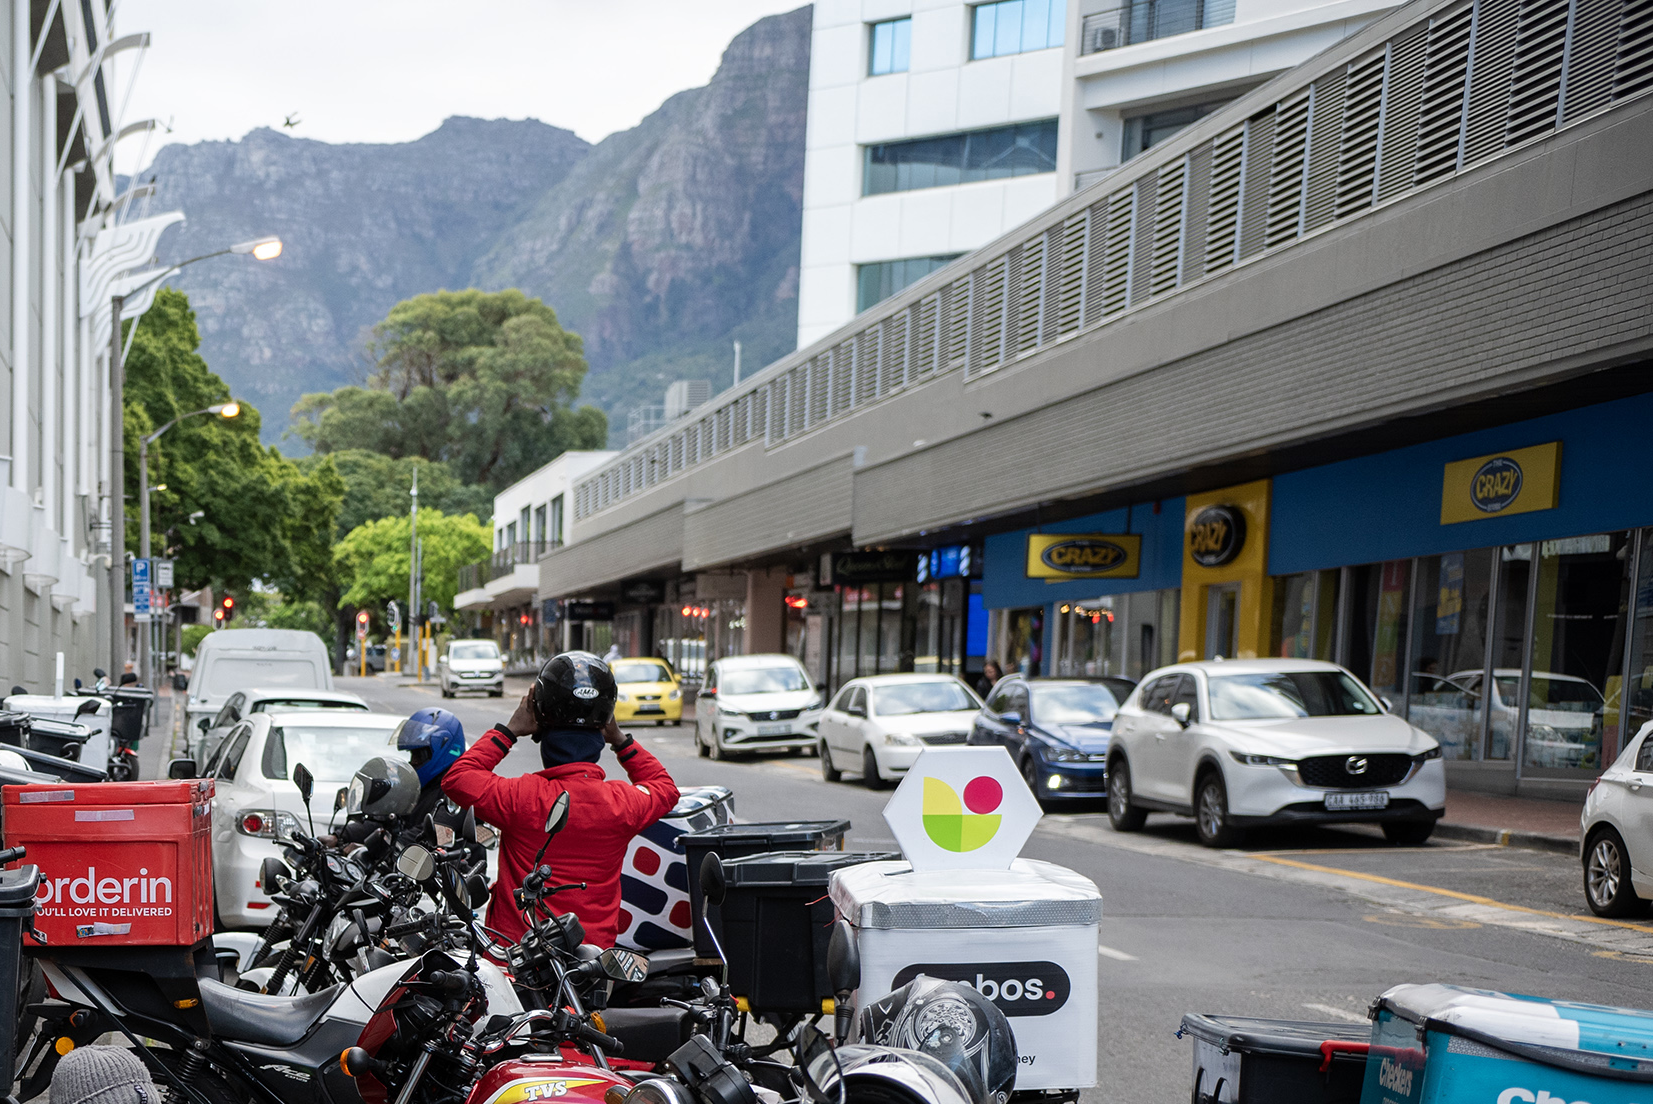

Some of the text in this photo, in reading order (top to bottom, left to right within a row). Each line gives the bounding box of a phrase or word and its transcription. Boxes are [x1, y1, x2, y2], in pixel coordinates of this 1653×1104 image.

[1476, 468, 1518, 500] CRAZY
[1050, 546, 1119, 565] CRAZY
[37, 907, 172, 917] OU'LL LOVE IT DELIVERED
[1379, 1057, 1413, 1098] Checkers
[524, 1080, 568, 1102] TVS
